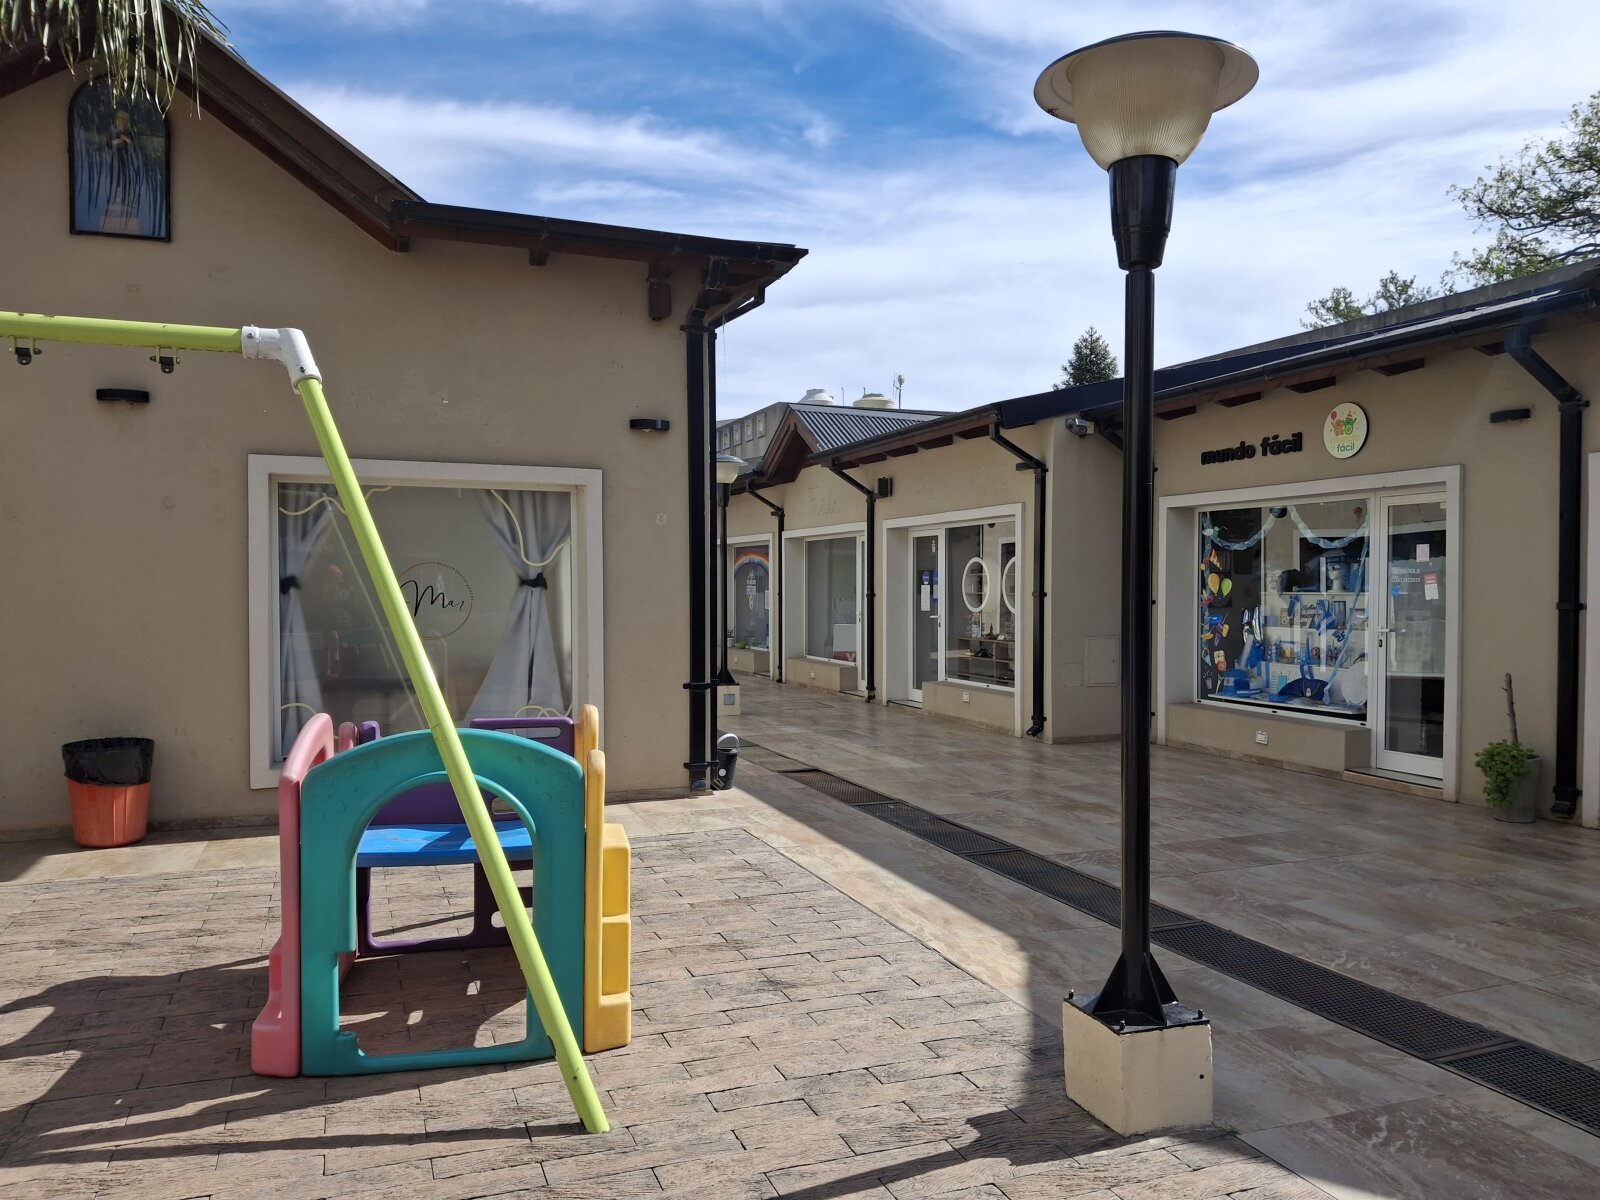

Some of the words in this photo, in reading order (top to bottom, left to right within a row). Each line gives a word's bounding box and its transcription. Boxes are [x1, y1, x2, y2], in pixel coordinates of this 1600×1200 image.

[1201, 441, 1256, 465] mundo
[1261, 432, 1303, 456] fácil
[1337, 442, 1355, 453] fácil
